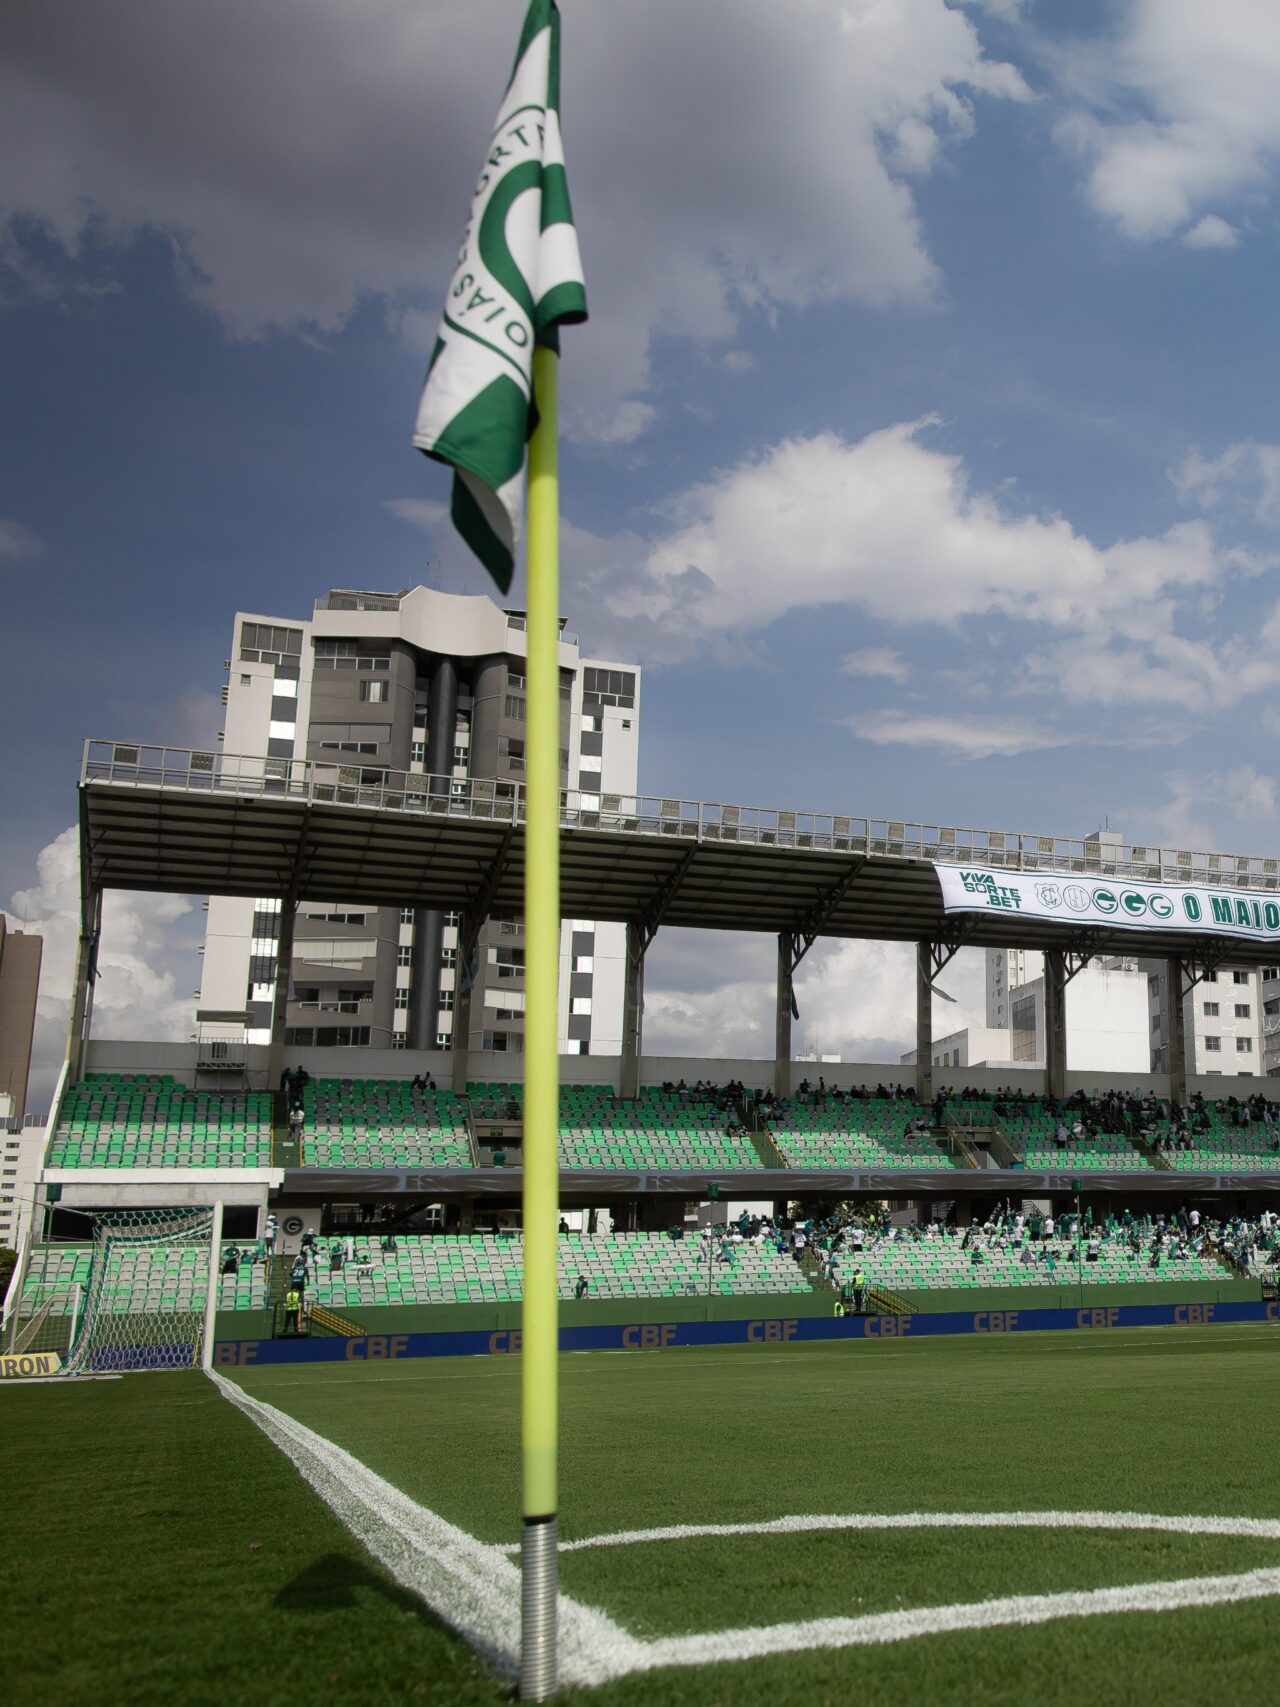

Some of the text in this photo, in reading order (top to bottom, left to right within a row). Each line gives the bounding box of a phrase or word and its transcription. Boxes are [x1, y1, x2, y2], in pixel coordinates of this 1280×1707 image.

[959, 871, 995, 885] VIVA
[964, 882, 1019, 899] SORTE
[986, 894, 1022, 909] .BET
[1183, 892, 1202, 923] O
[973, 1311, 1019, 1333] CBF
[1076, 1307, 1120, 1329] CBF
[1174, 1303, 1215, 1324] CBF
[622, 1324, 678, 1348] CBF
[747, 1319, 799, 1342] CBF
[864, 1315, 912, 1338] CBF
[345, 1335, 410, 1361] CBF
[489, 1331, 524, 1355] CB
[213, 1342, 260, 1367] BF
[0, 1356, 50, 1377] RON
